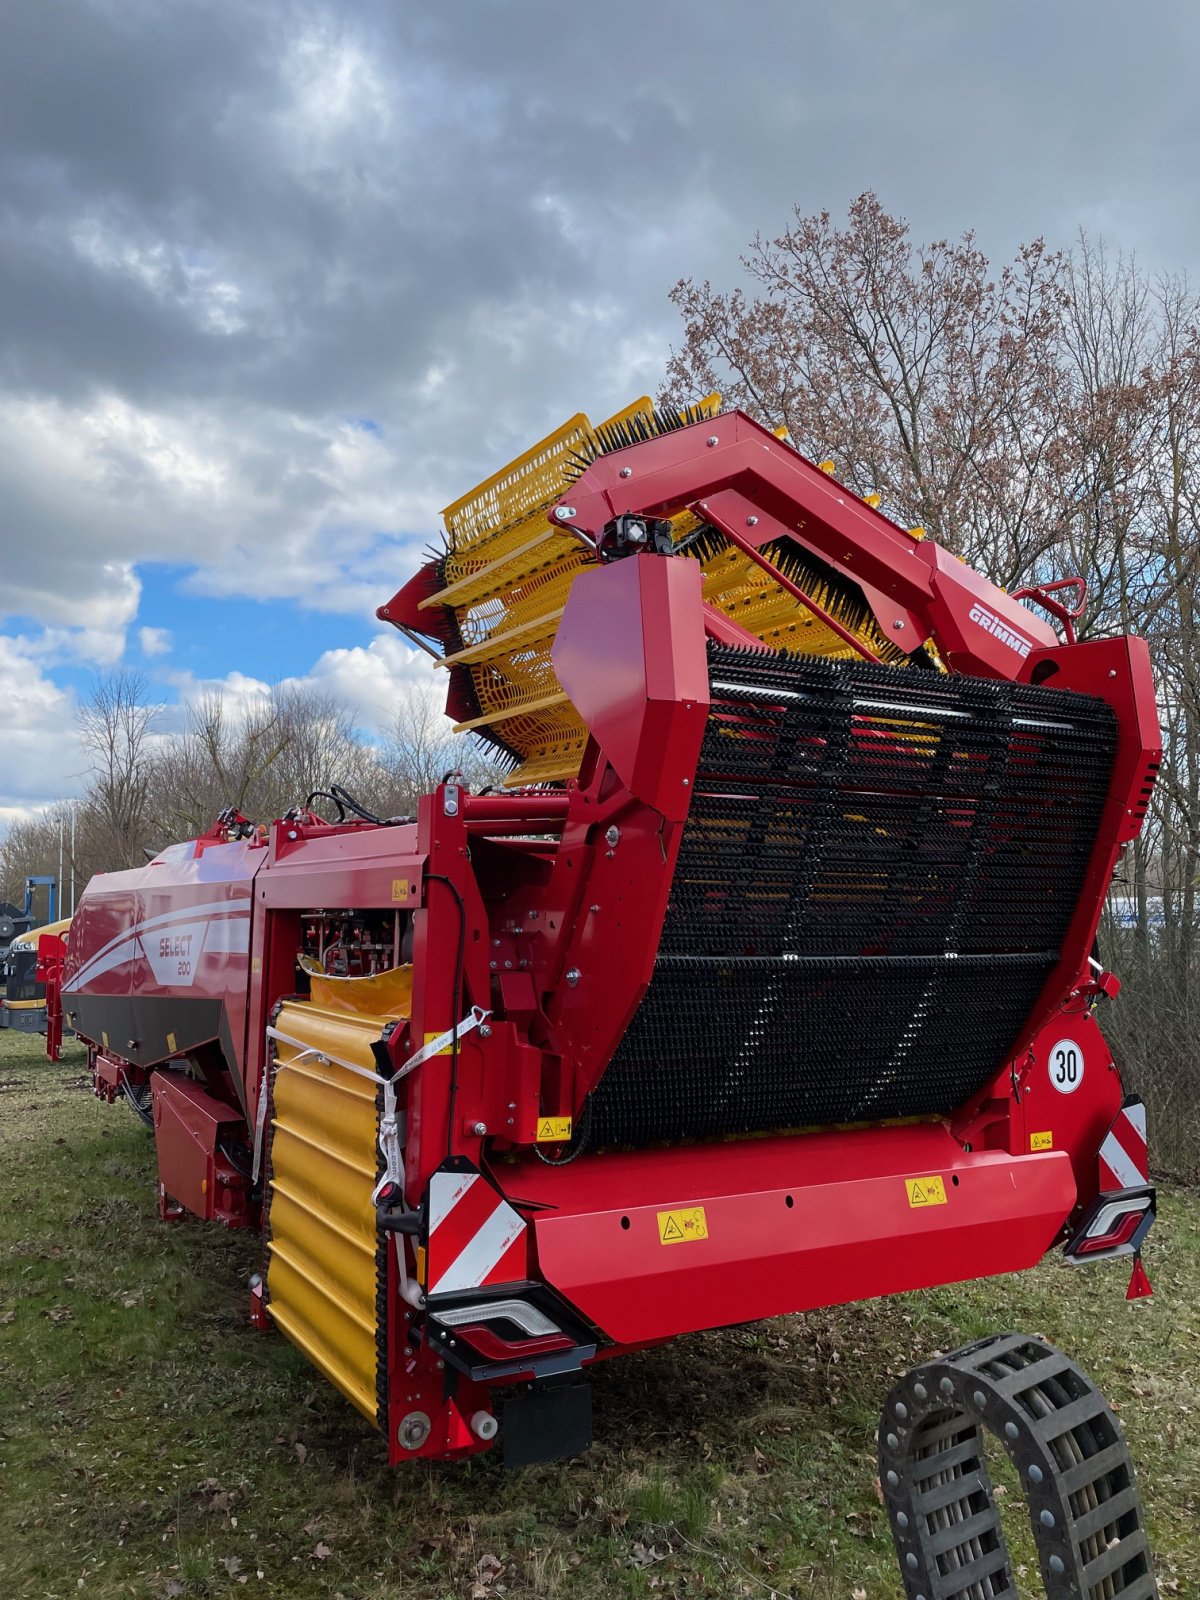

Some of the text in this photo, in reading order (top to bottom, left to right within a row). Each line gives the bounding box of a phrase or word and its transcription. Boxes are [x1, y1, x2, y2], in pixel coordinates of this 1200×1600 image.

[969, 603, 1033, 659] GRIMME
[159, 935, 193, 957] SELECT
[178, 960, 191, 976] 200
[1056, 1050, 1077, 1083] 30
